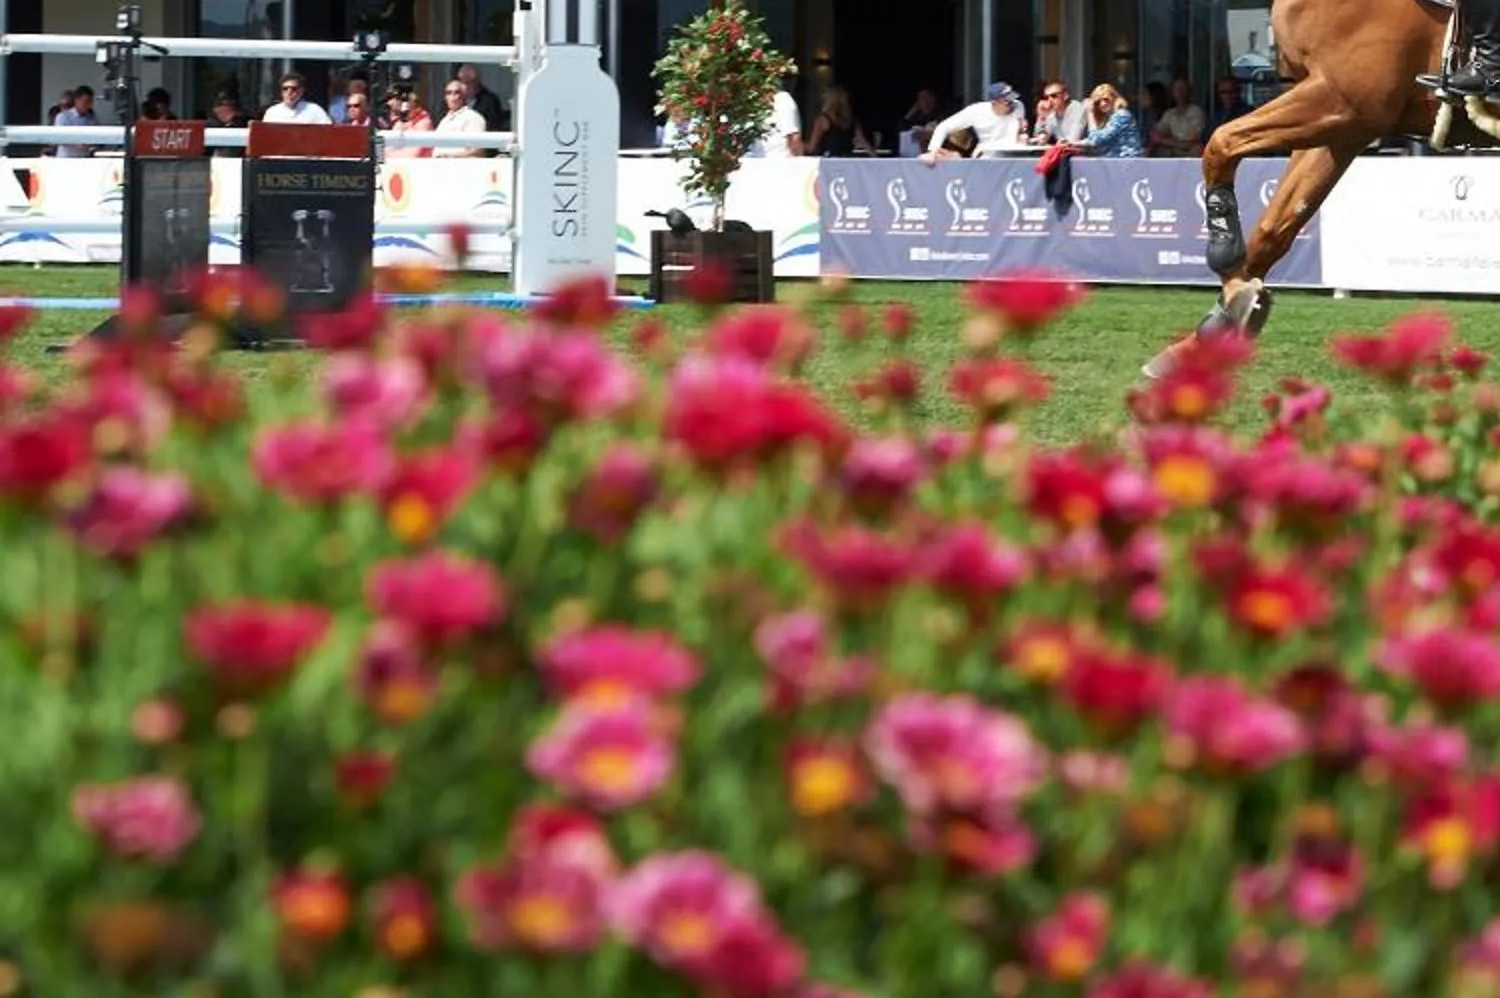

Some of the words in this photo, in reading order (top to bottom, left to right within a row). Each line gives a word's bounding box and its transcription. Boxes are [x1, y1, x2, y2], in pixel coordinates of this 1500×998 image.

[152, 128, 191, 150] START
[258, 173, 309, 189] HORSE
[312, 172, 368, 189] TIMING
[552, 121, 580, 237] SKINC
